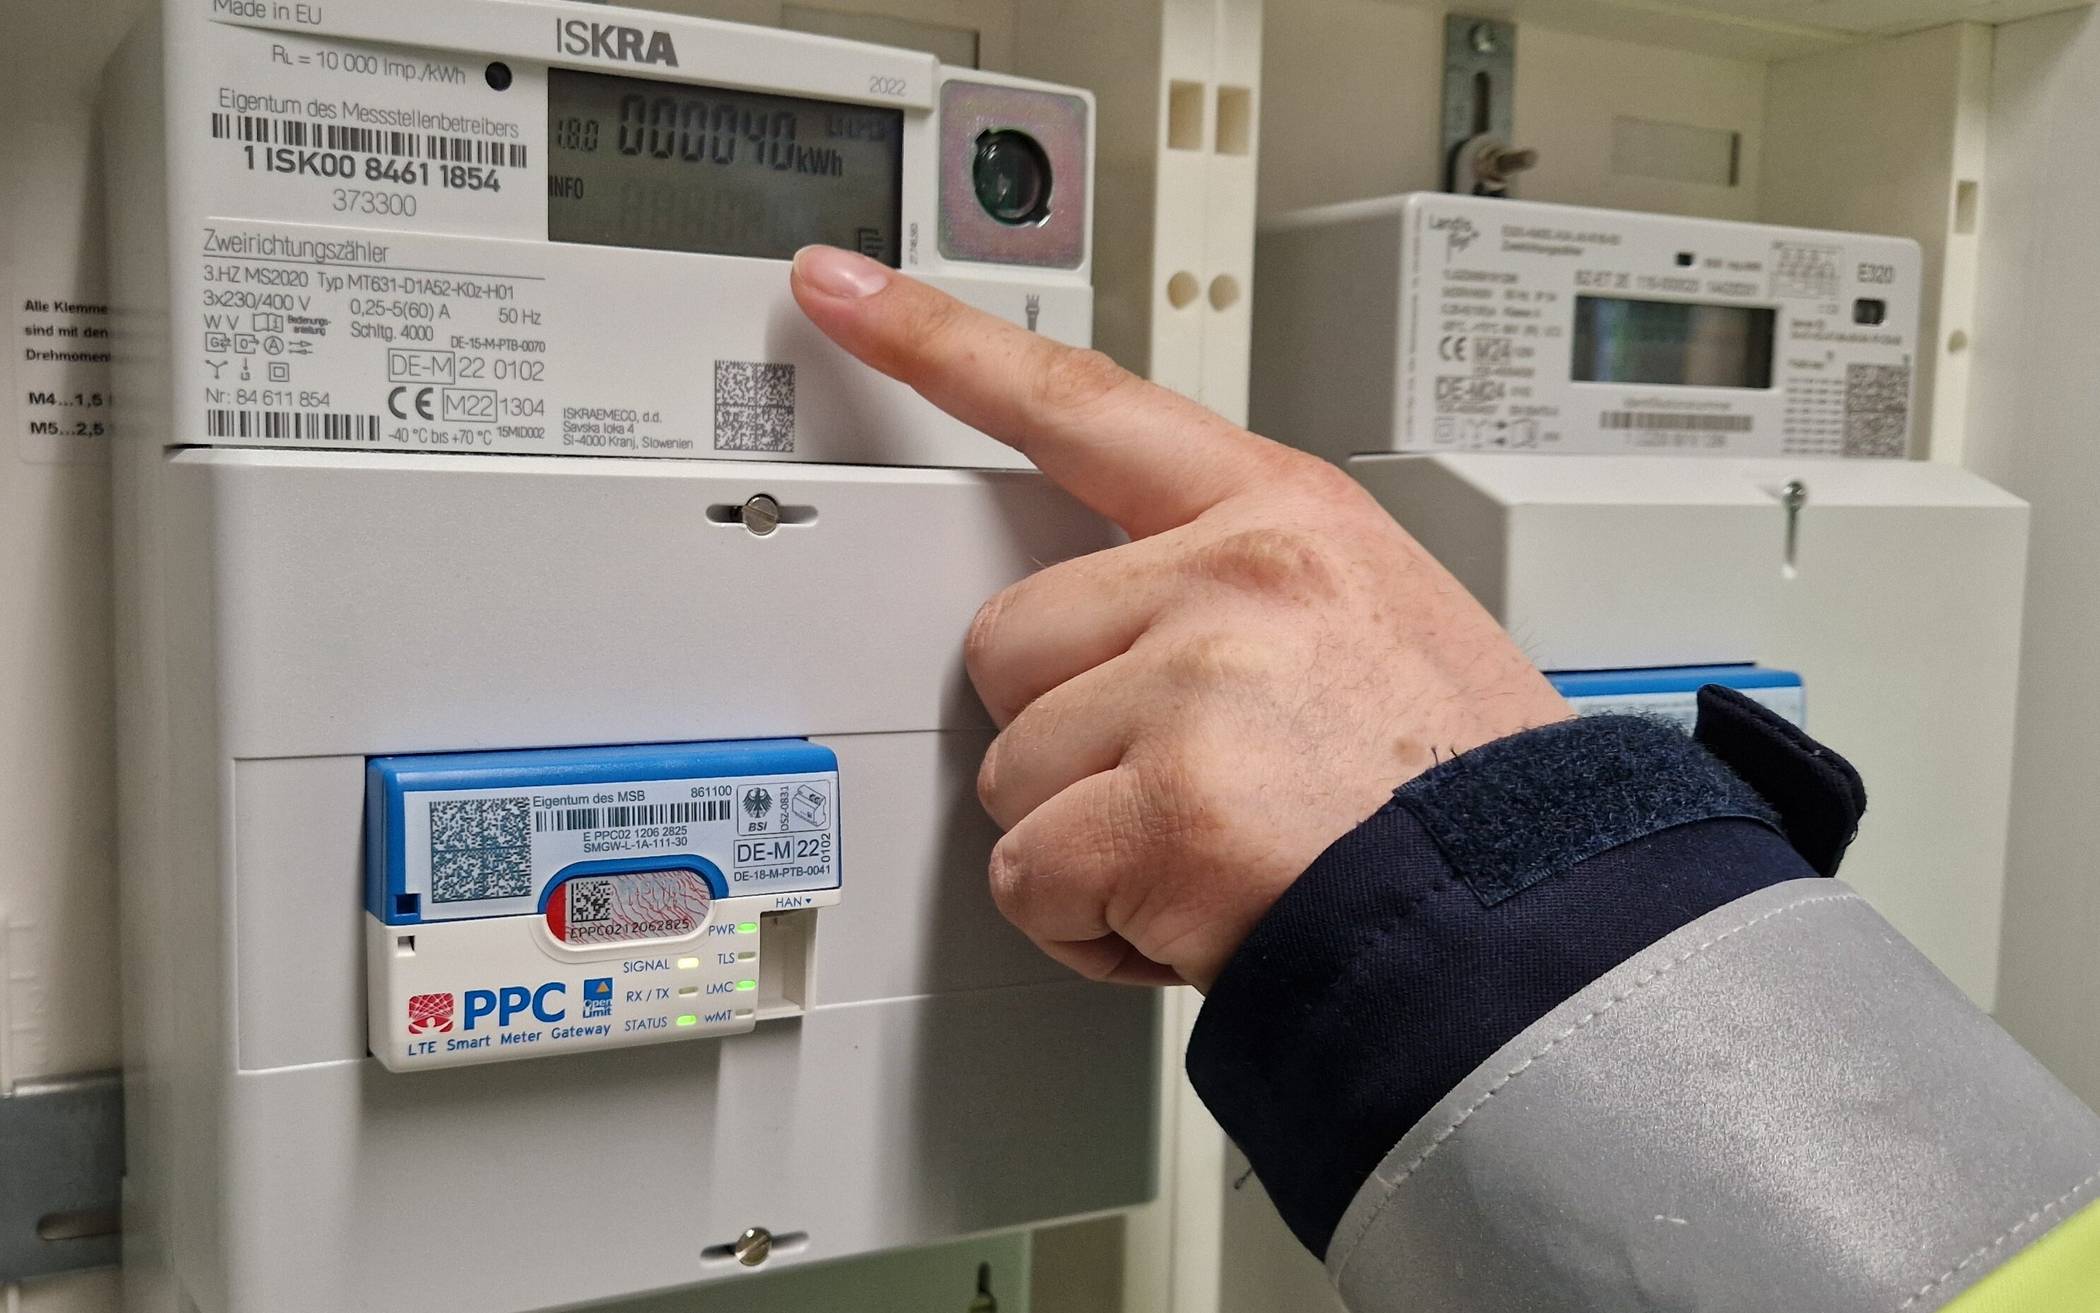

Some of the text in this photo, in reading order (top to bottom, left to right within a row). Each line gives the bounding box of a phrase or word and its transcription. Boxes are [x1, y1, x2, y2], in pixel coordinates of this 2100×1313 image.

[214, 0, 322, 25] Made in EU
[556, 18, 679, 67] ISKRA
[317, 51, 339, 70] 10
[343, 53, 378, 75] 000
[384, 56, 466, 85] Imp./kWh
[869, 76, 907, 97] 2022
[219, 87, 520, 139] Eigentum des Messstellenbetreibers
[266, 147, 357, 178] ISK00
[365, 157, 429, 186] 8461
[440, 164, 501, 192] 1854
[797, 146, 843, 177] kWh
[549, 175, 585, 199] INFO
[333, 188, 417, 217] 373300
[203, 228, 389, 263] Zweirichtungszähler
[203, 265, 241, 283] 3.HZ
[245, 267, 309, 287] MS2020
[317, 272, 344, 292] Typ
[25, 300, 49, 313] Alle
[203, 289, 294, 311] 3x230/400
[299, 296, 311, 311] V
[439, 304, 451, 319] A
[499, 308, 518, 324] 50
[522, 309, 542, 326] Hz
[24, 323, 109, 339] sind mit den
[287, 314, 332, 327] Bedienungs-
[400, 324, 434, 342] 4000
[450, 336, 546, 353] DE-15-M-PTB-0070
[391, 354, 545, 382] DE-M 22 0102
[236, 388, 258, 405] 84
[263, 390, 293, 406] 611
[299, 391, 331, 408] 854
[445, 394, 494, 417] M22
[500, 397, 545, 417] 1304
[563, 408, 663, 425] ISKRAEMECO, d.d.
[431, 429, 449, 444] bis
[452, 430, 475, 445] +70
[562, 421, 600, 434] Savska
[627, 424, 635, 434] 4
[562, 434, 694, 450] SI-4000 Kranj, Slowenien
[533, 784, 733, 810] Eigentum des MSB 861100
[780, 785, 790, 831] DSZ-0831
[583, 825, 688, 842] E PPC02 1206 2825
[748, 822, 767, 833] BSI
[583, 836, 688, 853] SMGW-L-1A-111-30
[737, 838, 820, 863] DE-M 22
[821, 833, 831, 863] 0102
[734, 865, 831, 882] DE-18-M-PTB-0041
[776, 897, 802, 908] HAN
[570, 918, 689, 939] EPPC0212062825
[708, 923, 736, 936] PWR
[623, 960, 670, 974] SIGNAL
[717, 952, 735, 965] TLS
[706, 981, 734, 995] LMC
[463, 982, 567, 1031] PPC
[624, 1016, 668, 1032] STATUS
[408, 1022, 612, 1056] LTE Smart Meter Gateway
